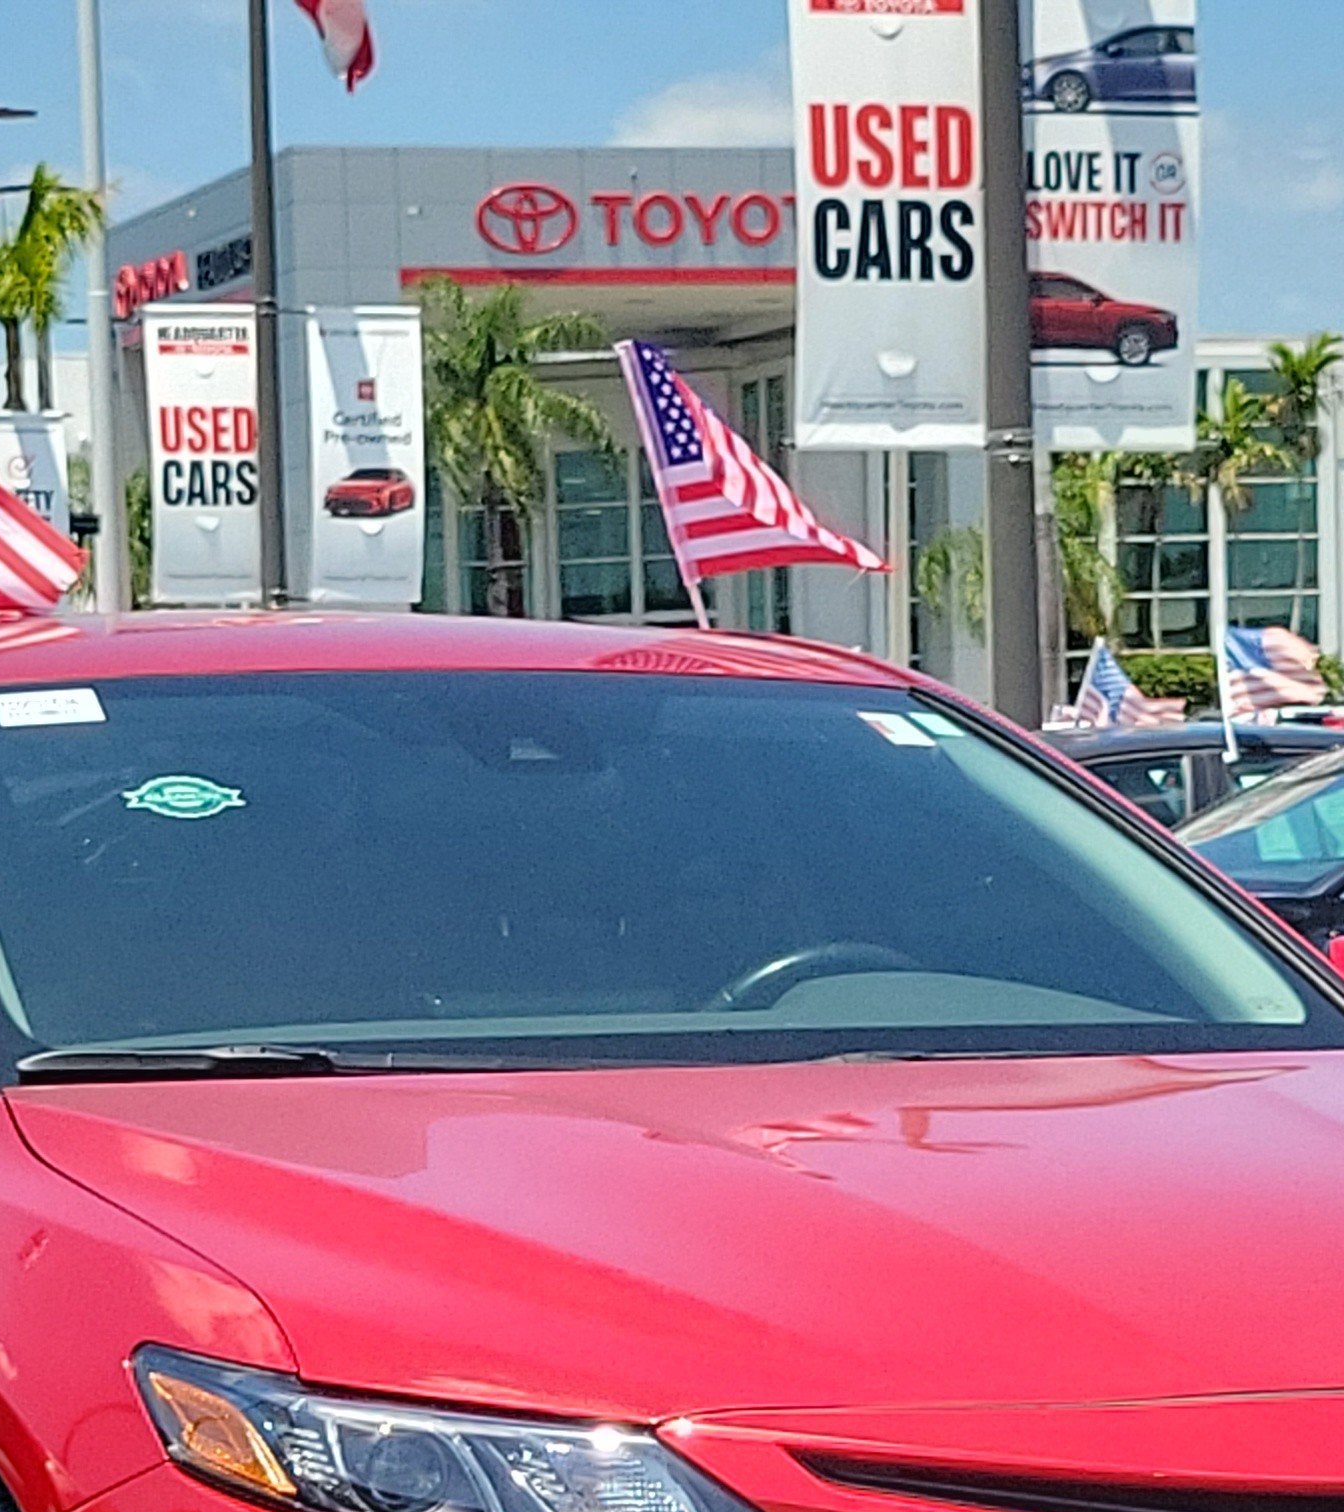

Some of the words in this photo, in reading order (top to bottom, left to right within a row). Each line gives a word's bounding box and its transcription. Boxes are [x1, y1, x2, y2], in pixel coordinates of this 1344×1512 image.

[809, 103, 973, 189] USED
[1027, 151, 1102, 192] LOVE
[1114, 152, 1142, 194] IT
[814, 198, 975, 281] CARS
[1026, 201, 1148, 241] SWITCH
[1159, 203, 1186, 242] IT
[159, 406, 257, 454] USED
[333, 410, 402, 427] Certified
[162, 459, 258, 507] CARS
